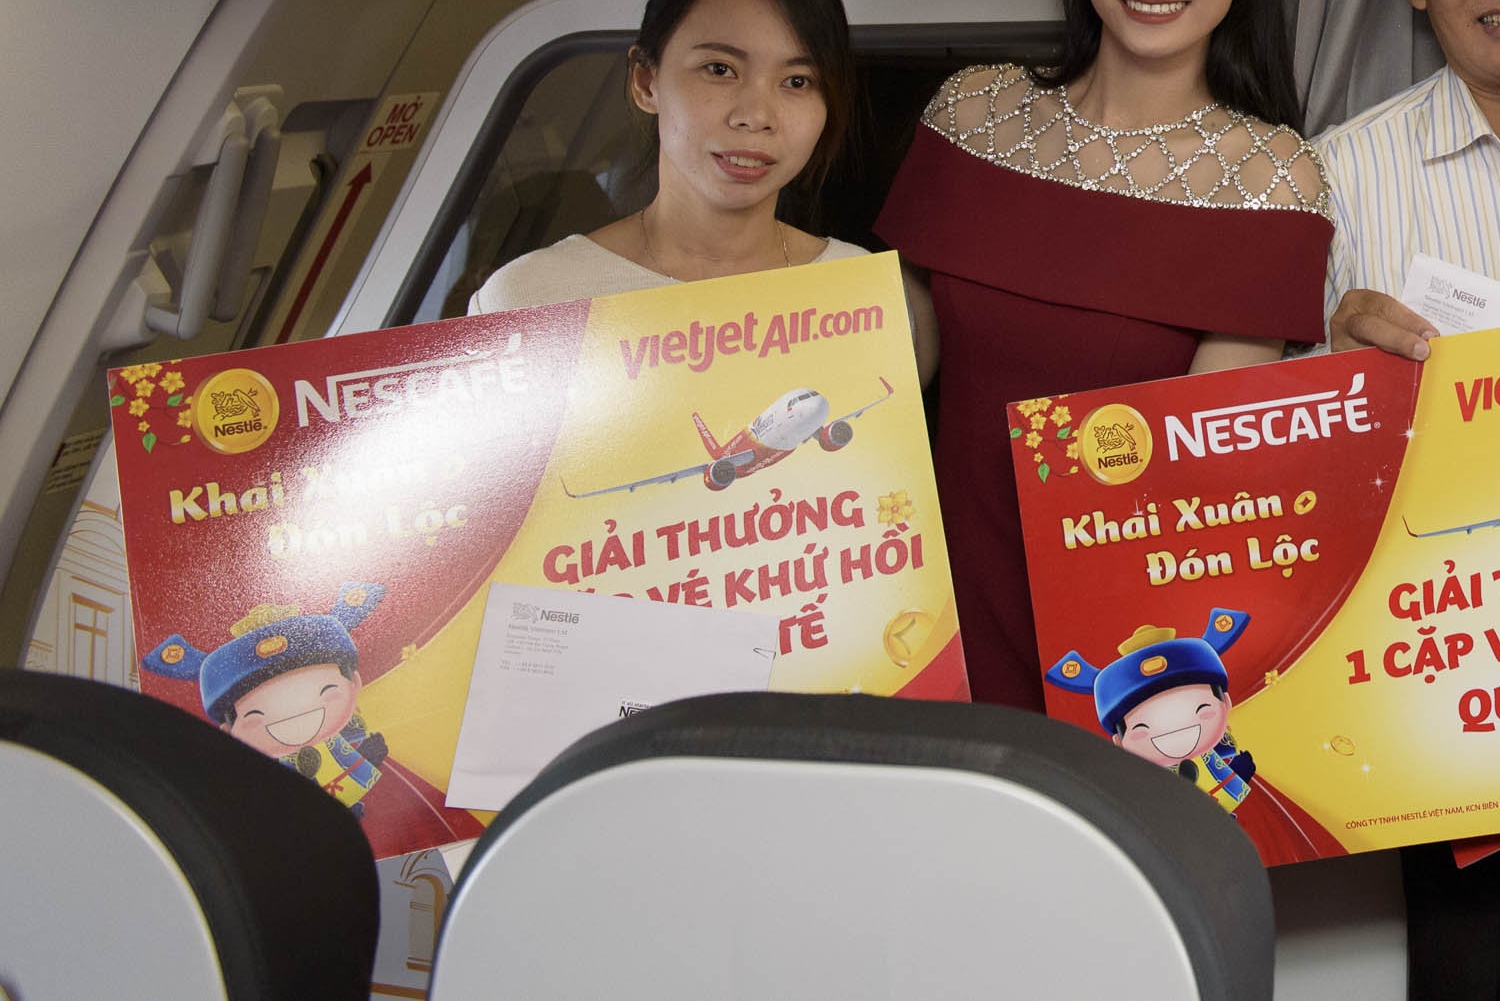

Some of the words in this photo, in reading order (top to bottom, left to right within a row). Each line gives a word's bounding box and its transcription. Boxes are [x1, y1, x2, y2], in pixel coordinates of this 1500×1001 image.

[366, 124, 420, 147] OPEN
[386, 95, 423, 124] MỞ
[294, 333, 529, 427] NESCAFÉ
[214, 418, 263, 438] Nestlé
[1164, 372, 1372, 462] NESCAFÉ
[1097, 451, 1139, 470] Nestlé
[168, 471, 286, 524] Khai
[1062, 502, 1162, 550] Khai
[1172, 491, 1284, 533] Xuân
[542, 519, 647, 586] GIẢI
[656, 488, 866, 562] THƯỞNG
[1146, 548, 1234, 586] Đón
[1246, 534, 1320, 578] Lộc
[724, 542, 831, 608] KHỨ
[840, 523, 925, 585] HỒI
[1388, 560, 1483, 622] GIẢI
[1346, 650, 1371, 684] 1
[1383, 626, 1474, 684] CẶP
[1345, 820, 1368, 830] CÔNG
[1368, 818, 1379, 826] TY
[1379, 815, 1400, 825] TNHH
[1400, 809, 1428, 822] NESTLÉ
[1428, 807, 1444, 818] VIỆT
[1445, 806, 1465, 815] NAM,
[1465, 803, 1481, 812] KCN
